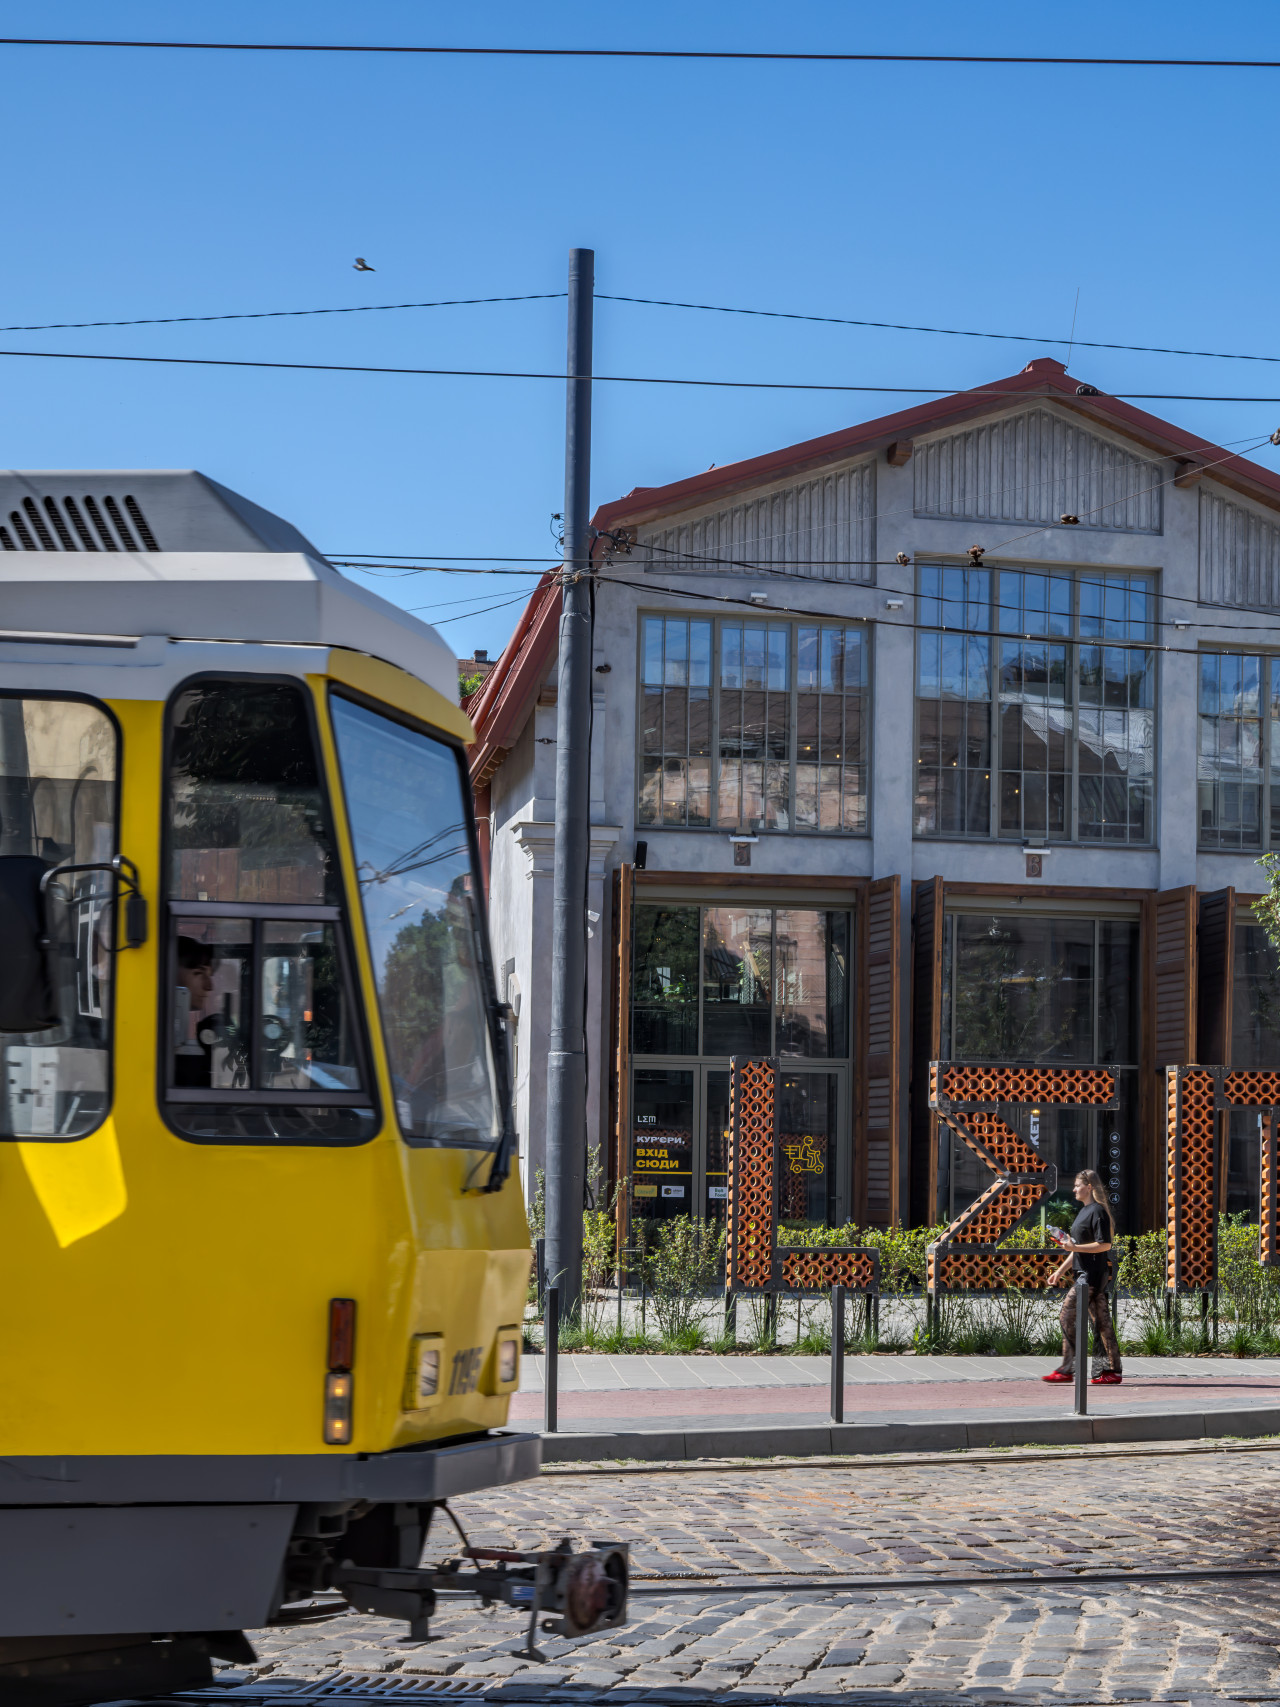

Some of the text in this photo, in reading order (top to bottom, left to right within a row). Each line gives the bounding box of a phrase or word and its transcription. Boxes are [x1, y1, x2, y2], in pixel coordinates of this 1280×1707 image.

[1030, 1114, 1039, 1149] KET
[636, 1136, 685, 1144] КУР'ЄРИ,
[636, 1148, 668, 1158] ВХІД
[635, 1160, 679, 1169] СЮДИ
